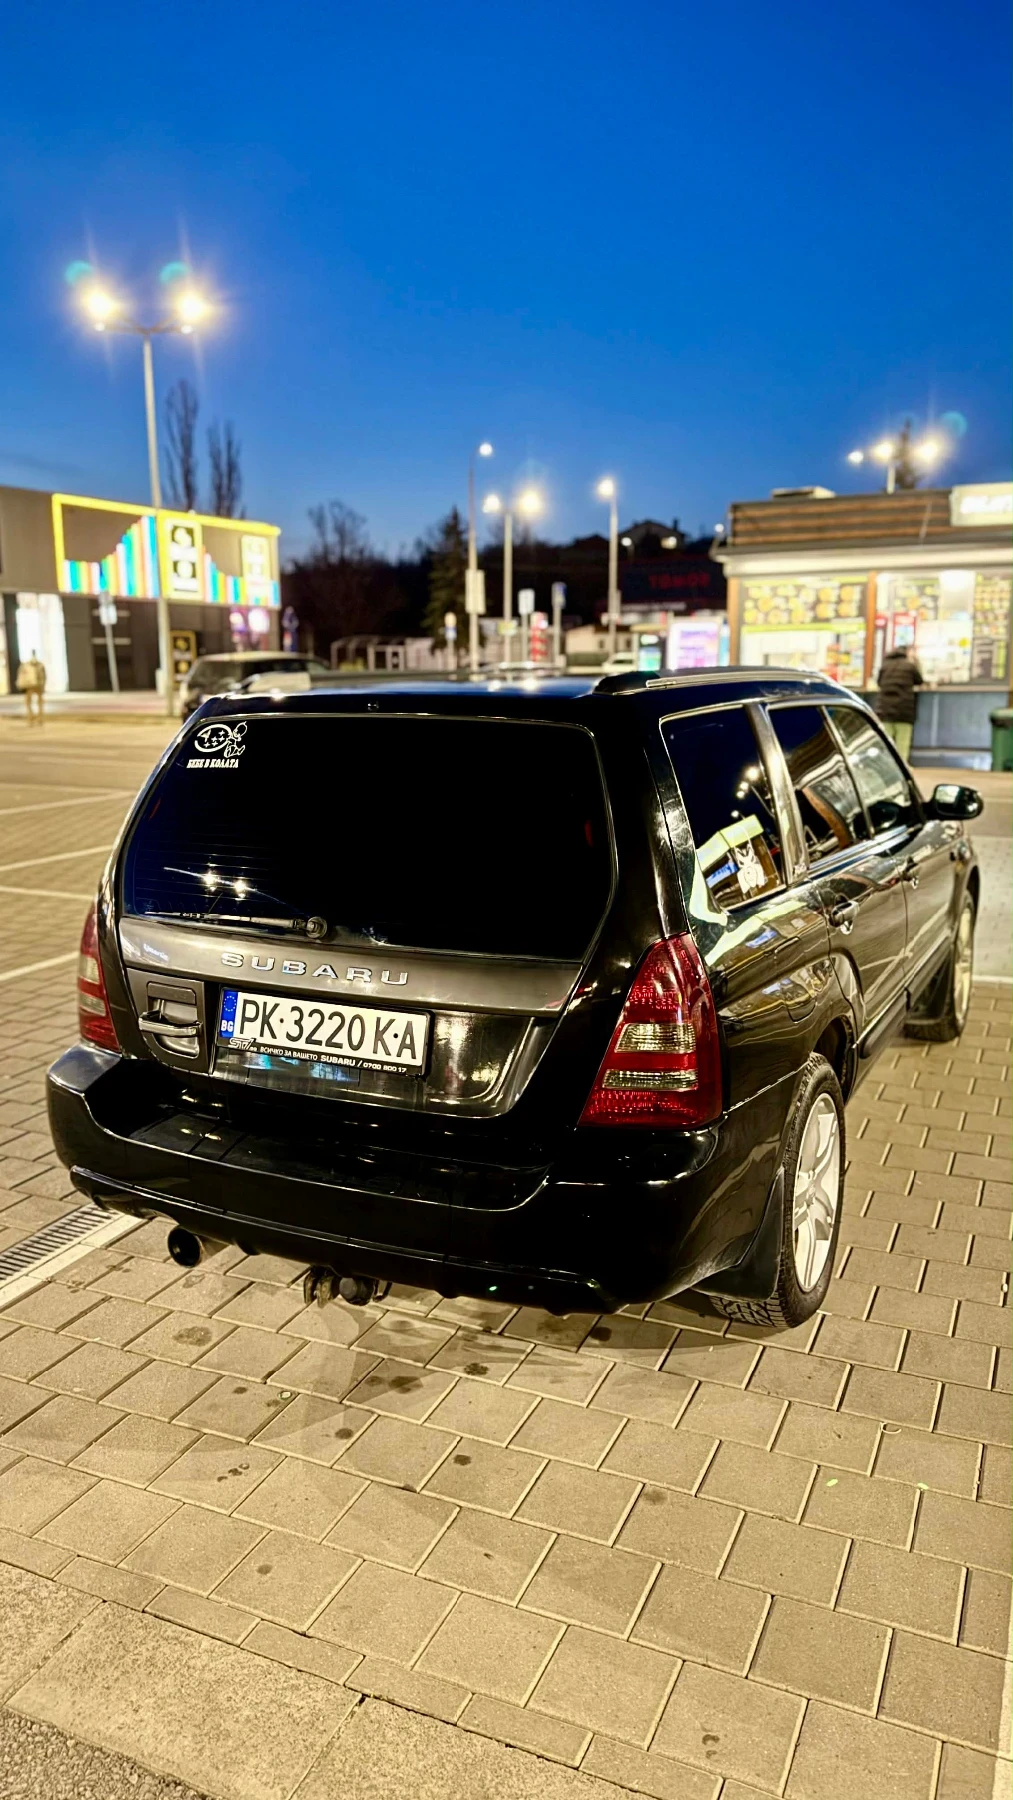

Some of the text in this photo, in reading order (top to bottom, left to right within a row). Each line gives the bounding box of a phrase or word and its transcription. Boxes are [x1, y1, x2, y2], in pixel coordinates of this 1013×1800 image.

[221, 952, 408, 986] SUBARU
[220, 1020, 234, 1032] BG
[260, 1046, 284, 1057] ВСИЧКО
[292, 1051, 318, 1061] ВАШЕТО
[320, 1055, 356, 1067] SUBARU
